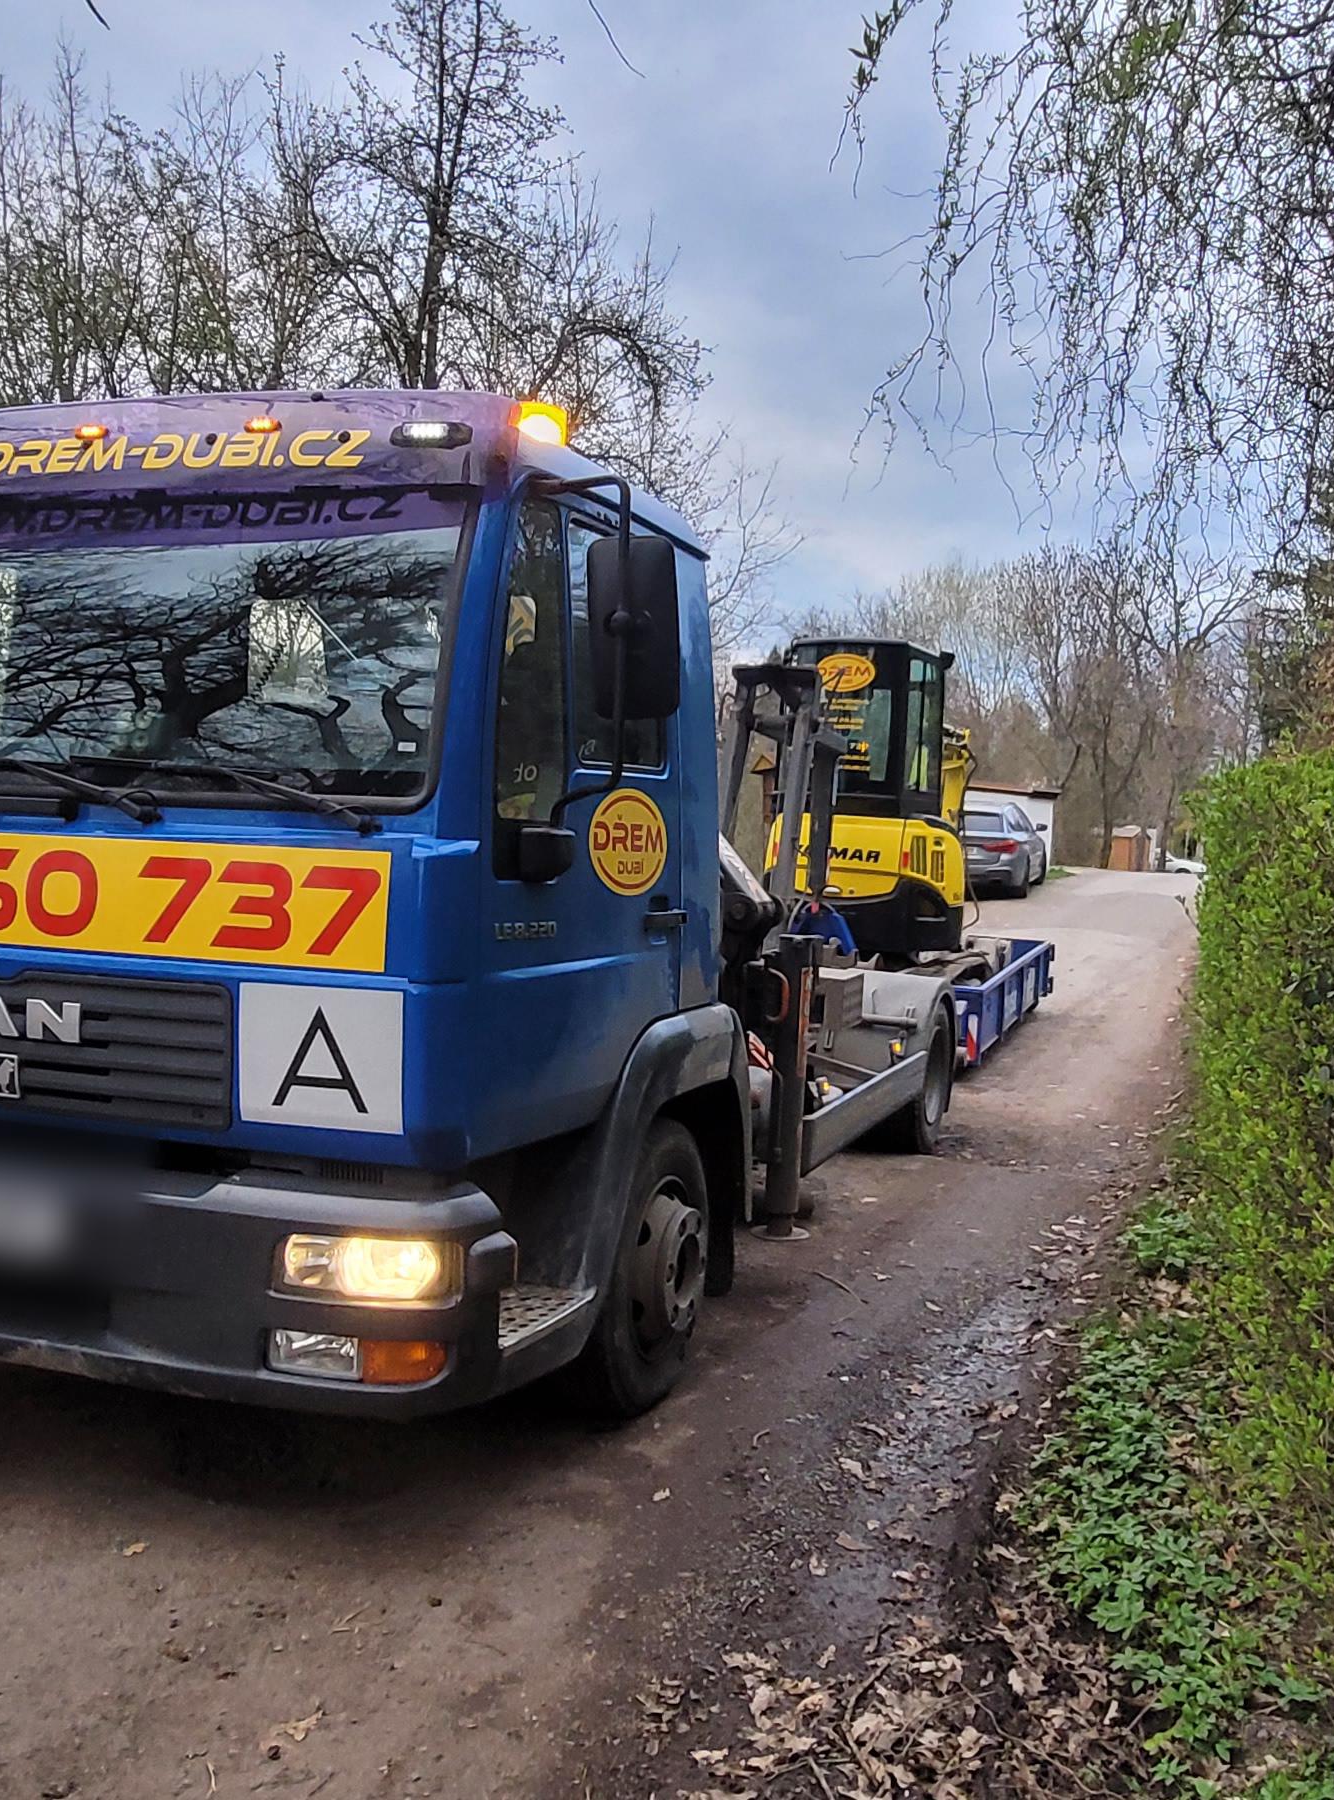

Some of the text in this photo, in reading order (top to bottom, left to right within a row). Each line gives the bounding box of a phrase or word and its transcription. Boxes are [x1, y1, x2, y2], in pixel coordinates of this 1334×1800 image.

[592, 814, 664, 854] DŘEM
[137, 856, 382, 956] 737
[270, 1004, 370, 1114] A
